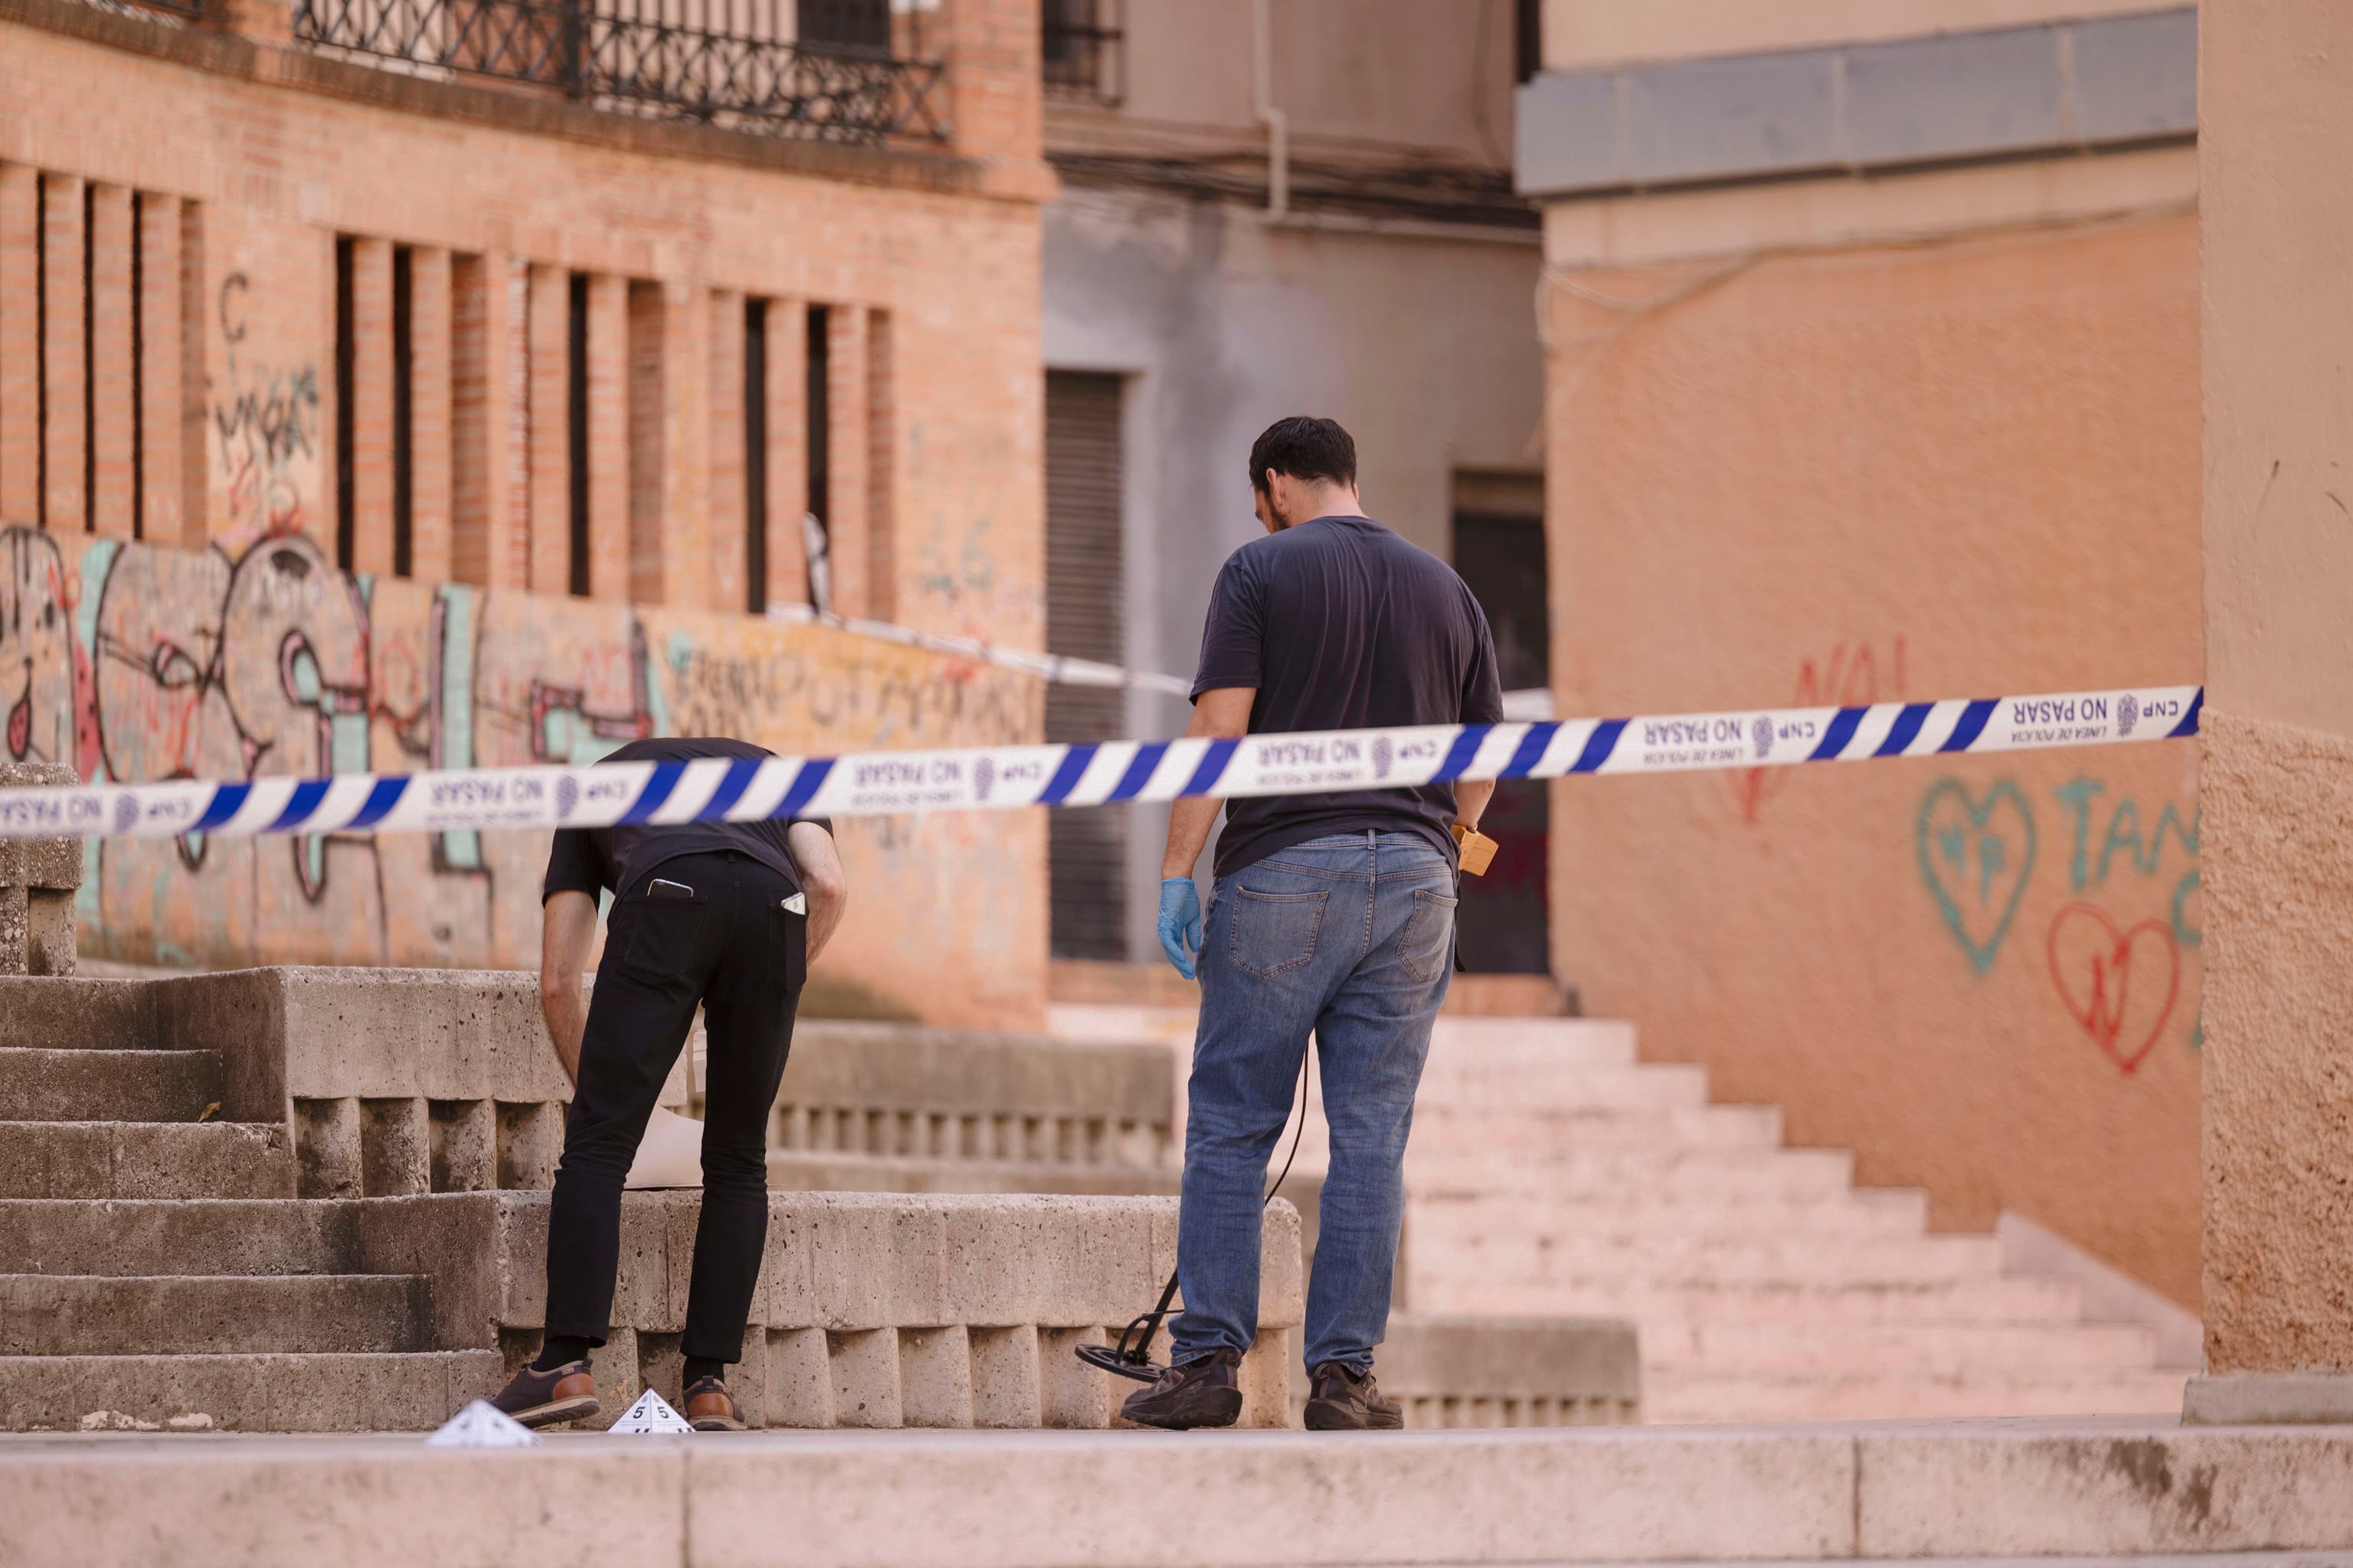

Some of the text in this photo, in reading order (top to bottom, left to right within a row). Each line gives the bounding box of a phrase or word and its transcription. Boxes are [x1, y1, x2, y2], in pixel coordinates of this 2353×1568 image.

[2014, 699, 2107, 725] NO PASAR
[2143, 700, 2178, 717] CNP
[1645, 719, 1742, 745] NO PASAR
[1778, 722, 1815, 739] CNP
[1258, 738, 1360, 767] NO PASAR
[1400, 741, 1437, 758] CNP
[855, 760, 961, 787] NO PASAR
[431, 776, 544, 805] NO PASAR
[0, 797, 102, 827] NO PASA
[633, 1406, 645, 1419] 5
[657, 1406, 669, 1419] 5
